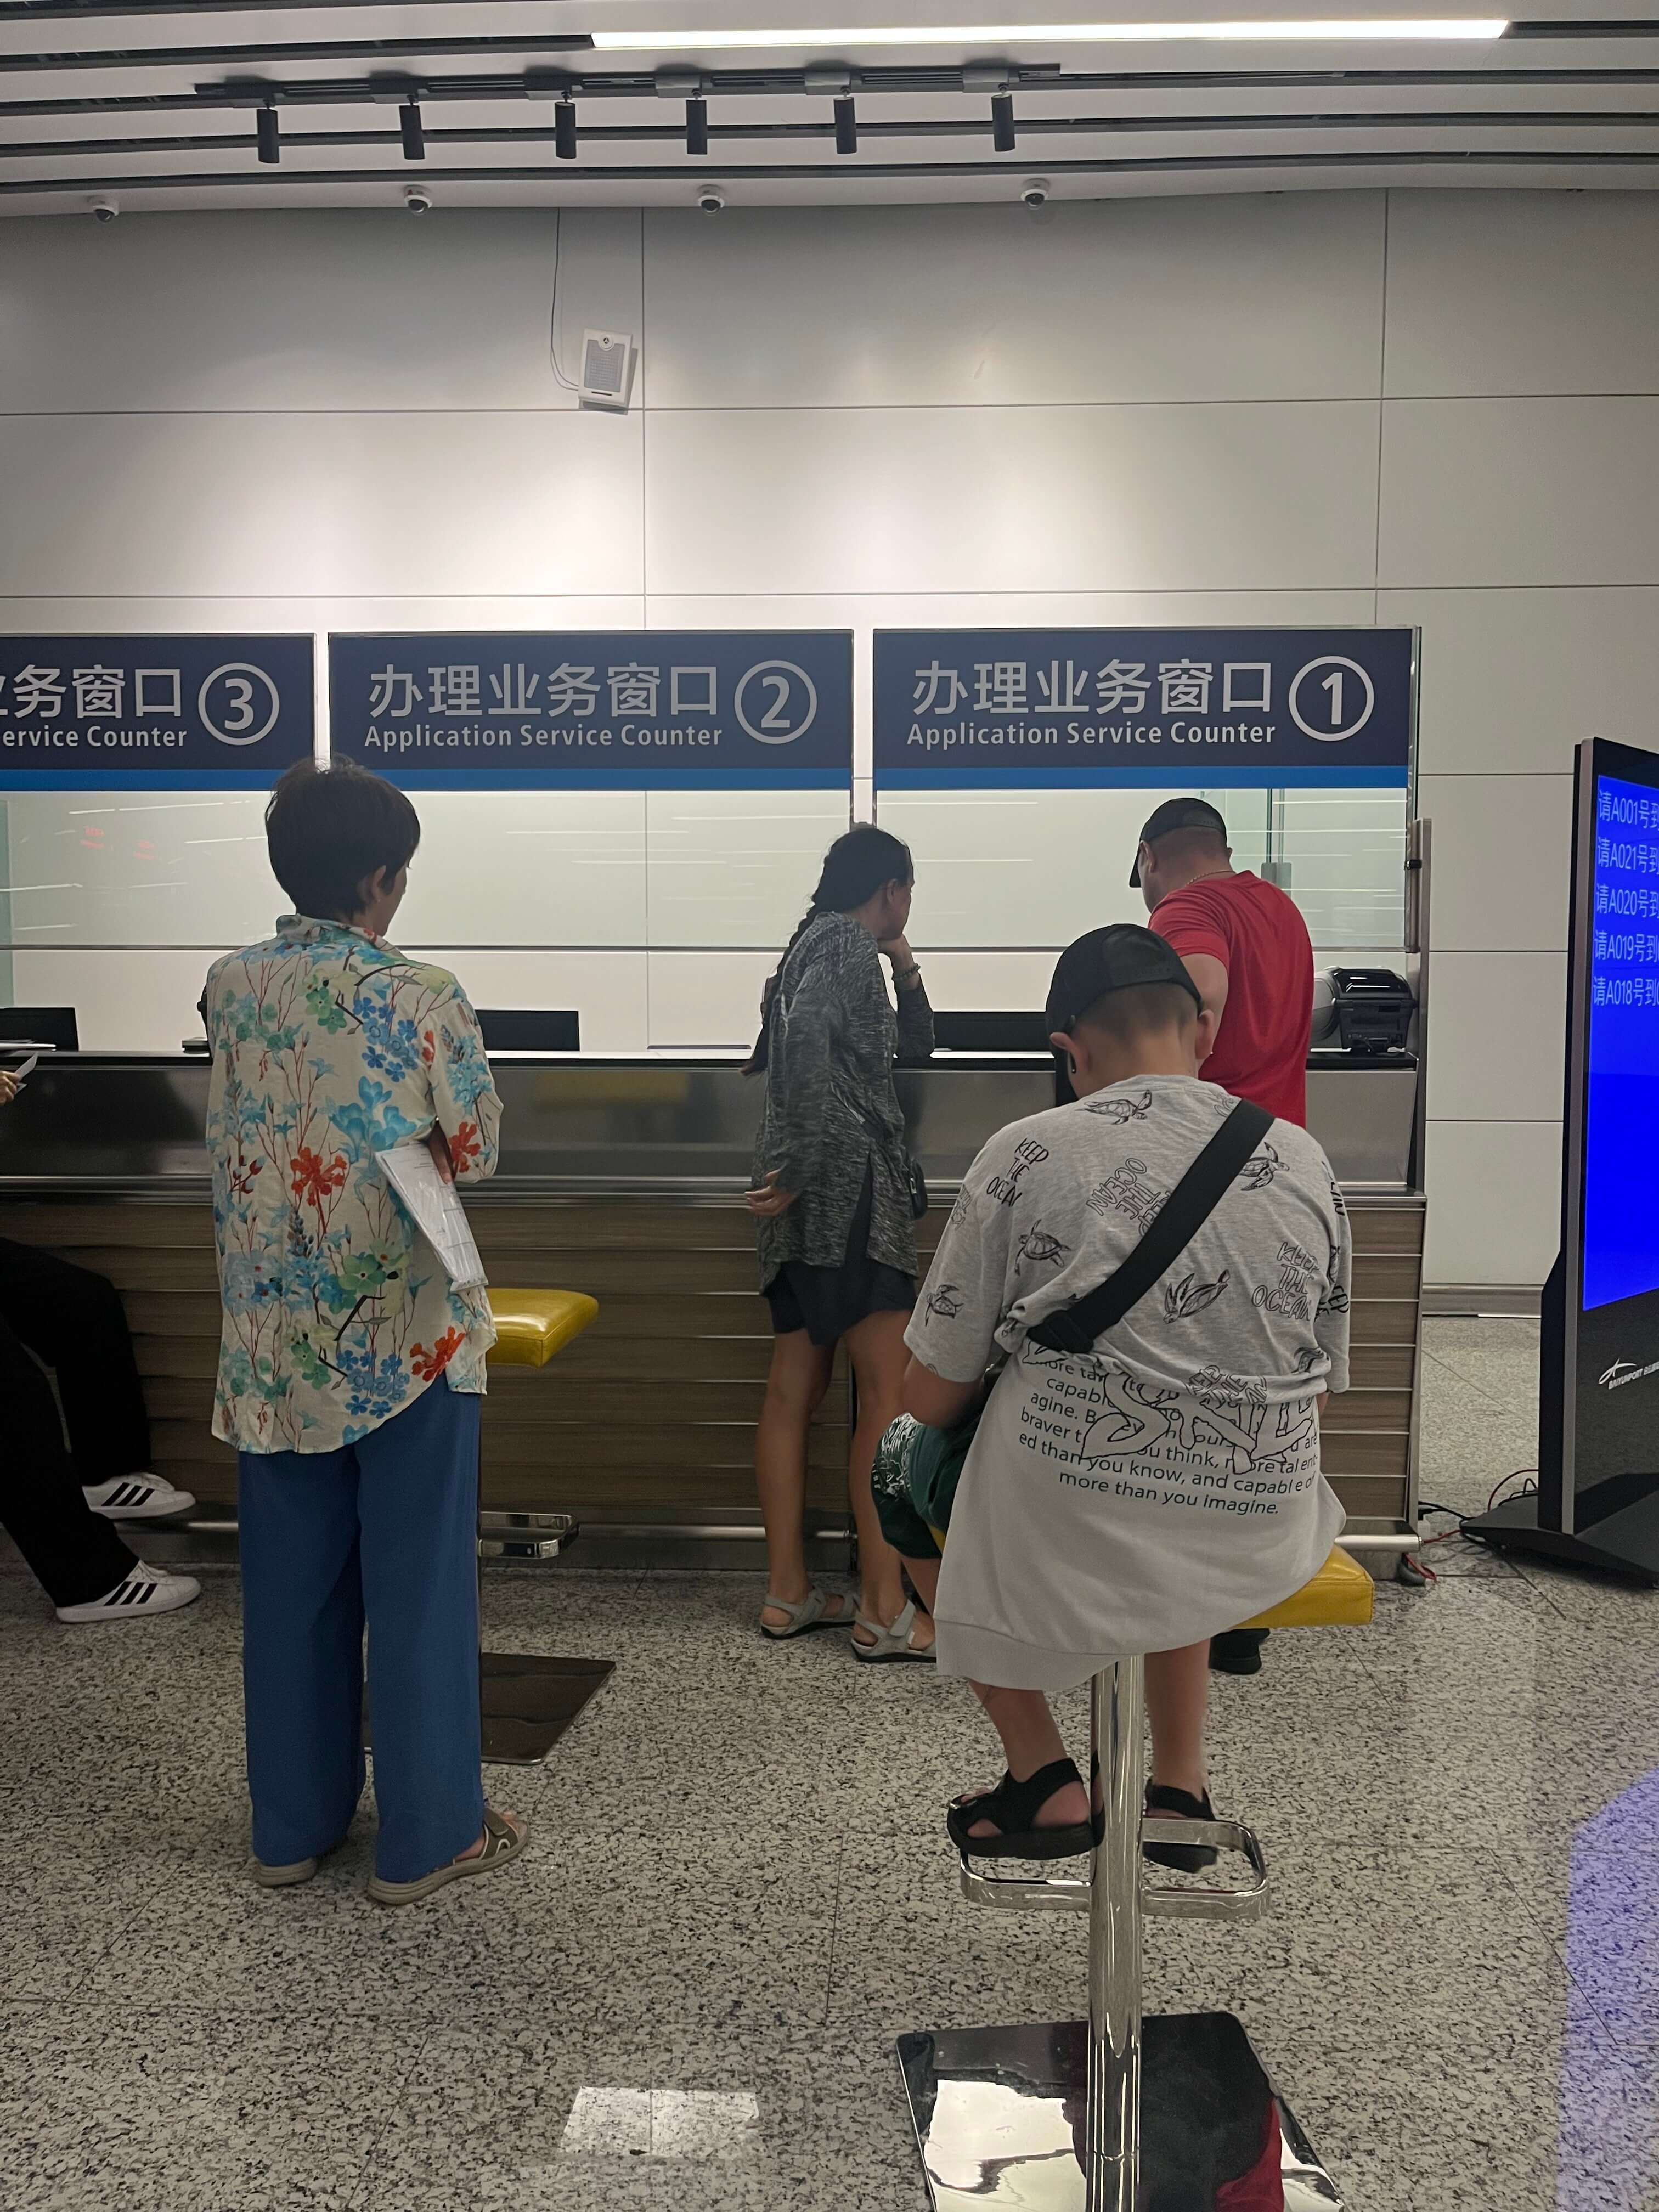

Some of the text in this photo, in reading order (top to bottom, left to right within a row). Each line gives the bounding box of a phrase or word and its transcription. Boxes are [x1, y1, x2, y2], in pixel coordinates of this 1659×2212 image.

[0, 664, 182, 719] 务窗口
[369, 662, 716, 718] 办理业务窗口
[912, 658, 1271, 715] 办理业务窗口
[2, 725, 187, 747] ervice Counter
[364, 724, 723, 752] Application Service Counter
[907, 721, 1276, 751] Application Service Counter
[1594, 930, 1659, 962] 请A019号到
[1014, 1137, 1049, 1165] KEEP
[1006, 1156, 1030, 1183] THE
[1086, 1158, 1148, 1216] OCEAN
[1115, 1182, 1161, 1221] THE
[1044, 1359, 1075, 1375] ore
[1031, 1393, 1078, 1420] agine.
[1021, 1406, 1071, 1440] braver
[1019, 1432, 1037, 1451] ed
[1042, 1440, 1083, 1466] than
[1086, 1458, 1124, 1475] you
[1130, 1459, 1186, 1485] know,
[1192, 1474, 1229, 1489] and
[1166, 1446, 1219, 1469] think,
[1059, 1471, 1279, 1516] more than you imagine.
